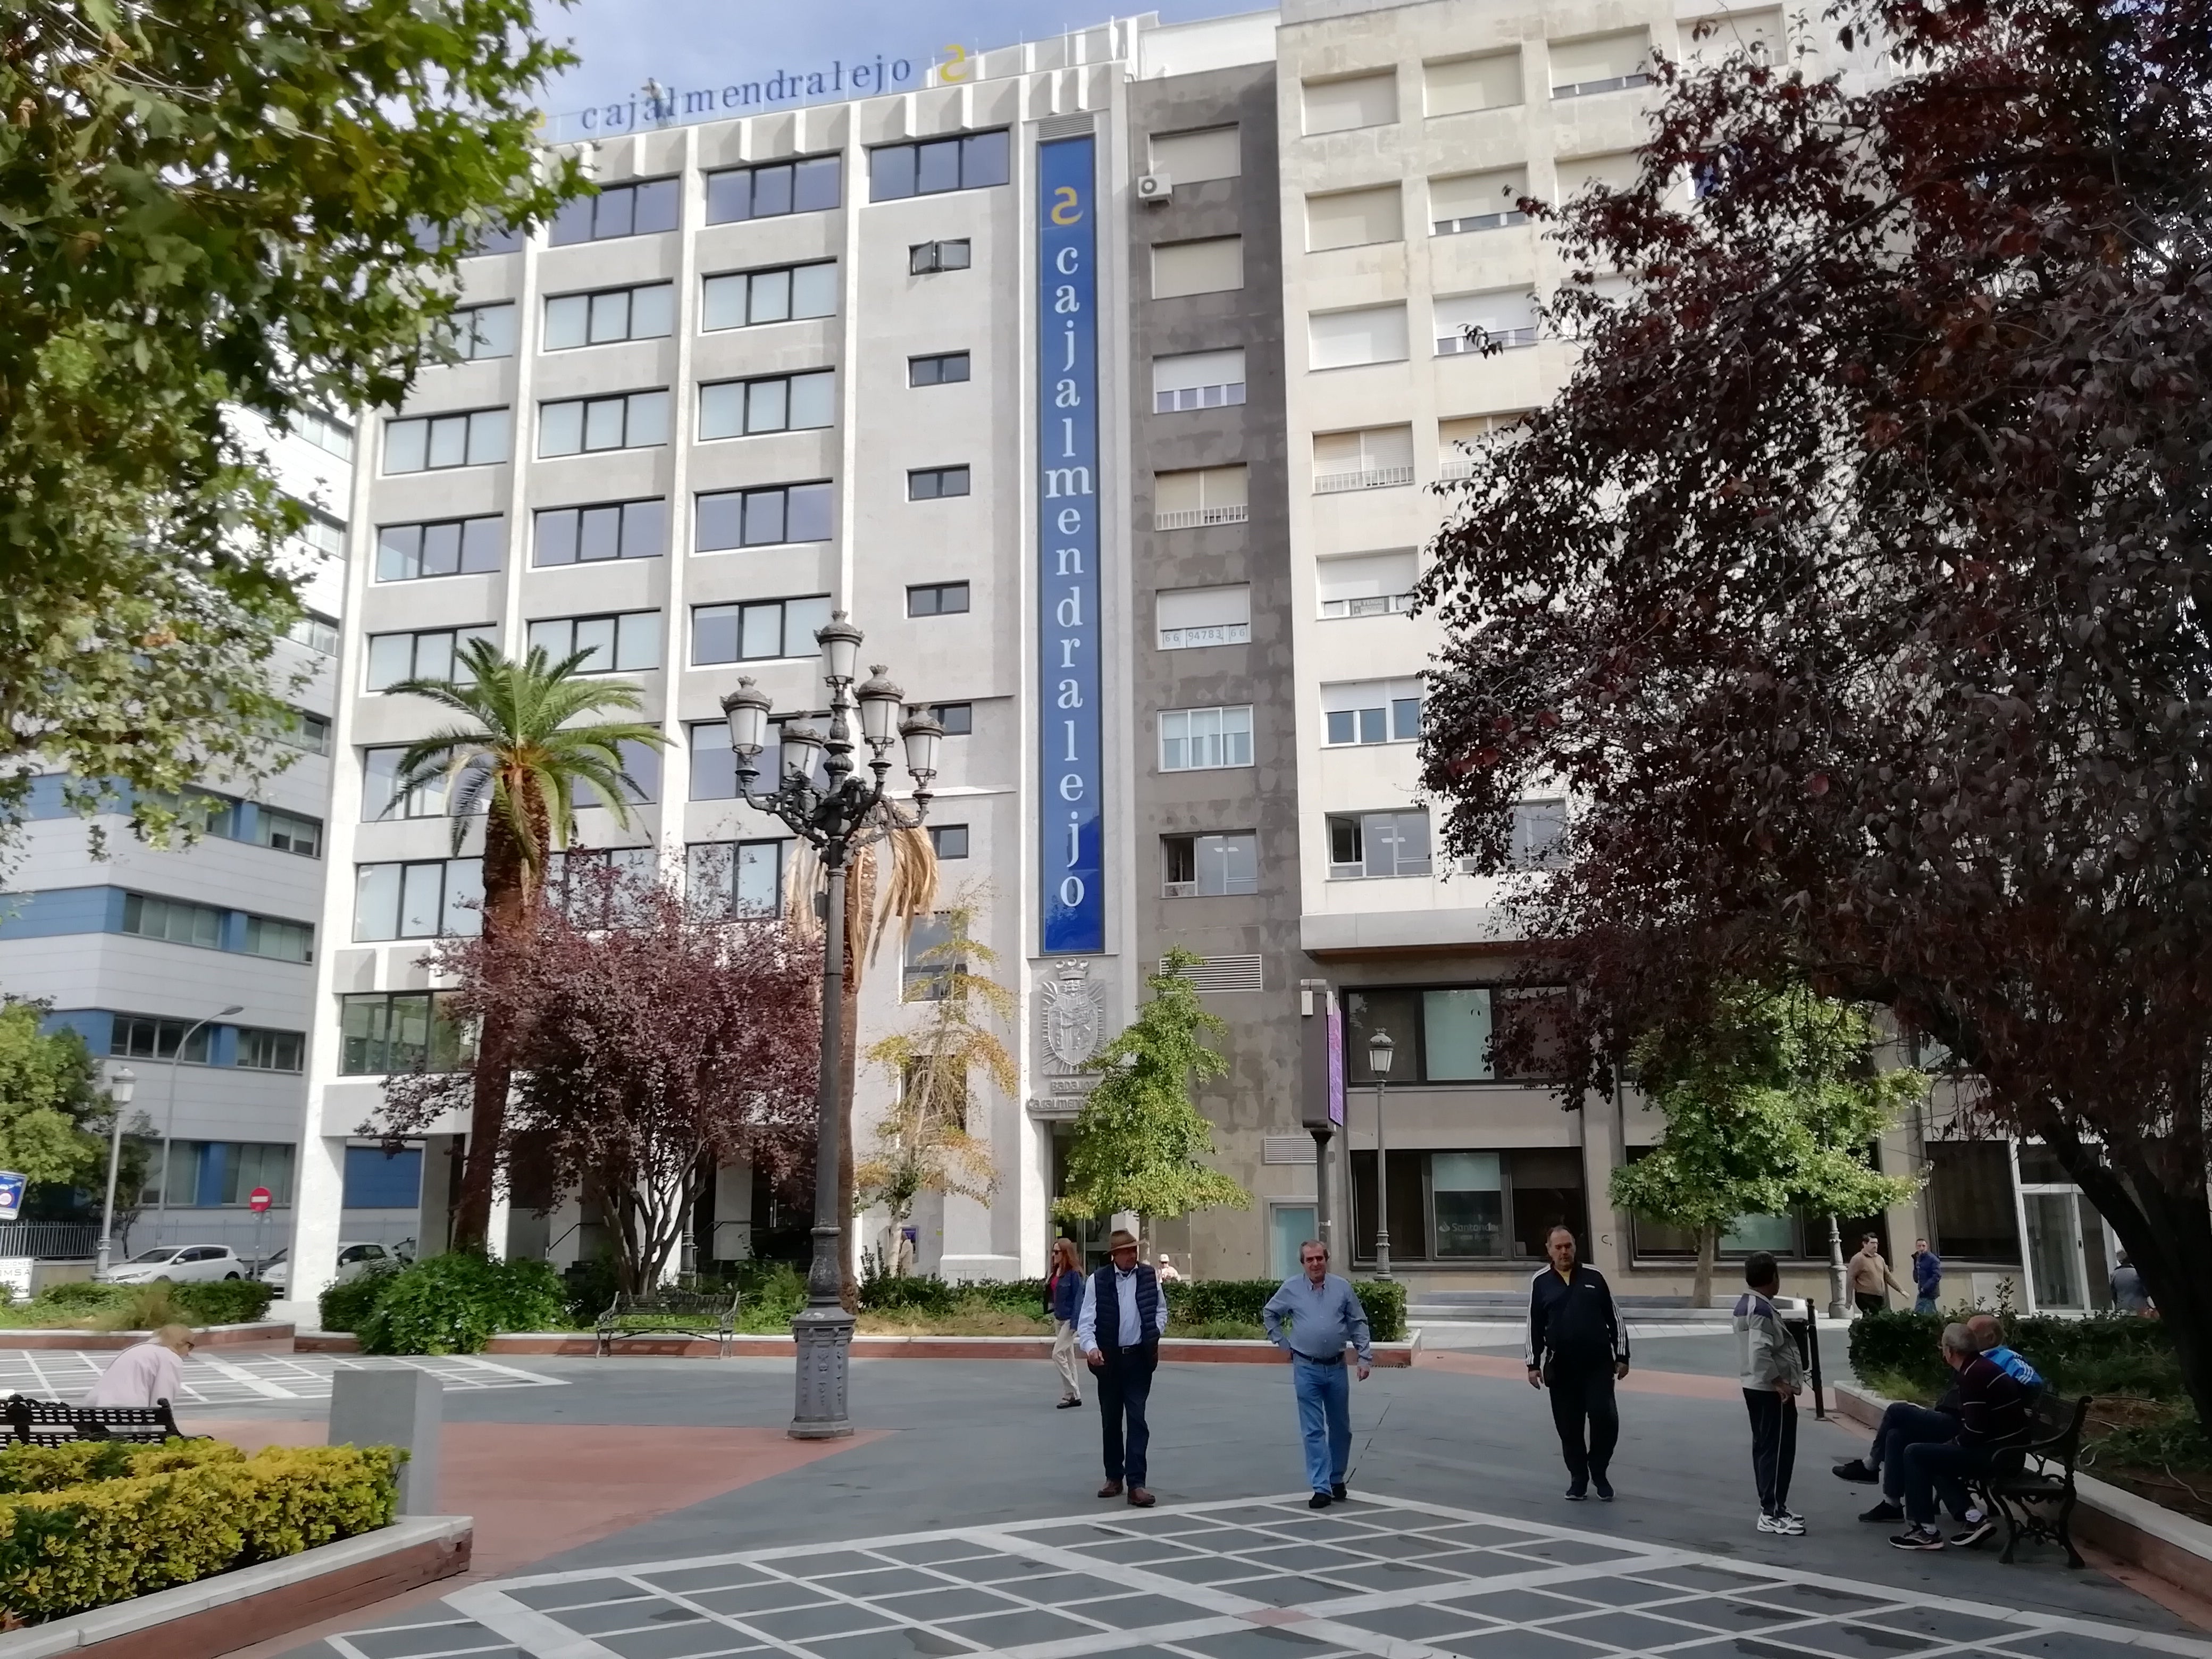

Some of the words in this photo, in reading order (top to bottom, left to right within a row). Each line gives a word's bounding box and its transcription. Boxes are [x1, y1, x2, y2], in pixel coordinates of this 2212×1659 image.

[581, 55, 911, 132] cajalmendralejo
[1045, 247, 1093, 907] cajalmendralejo
[1452, 1222, 1499, 1231] Santander
